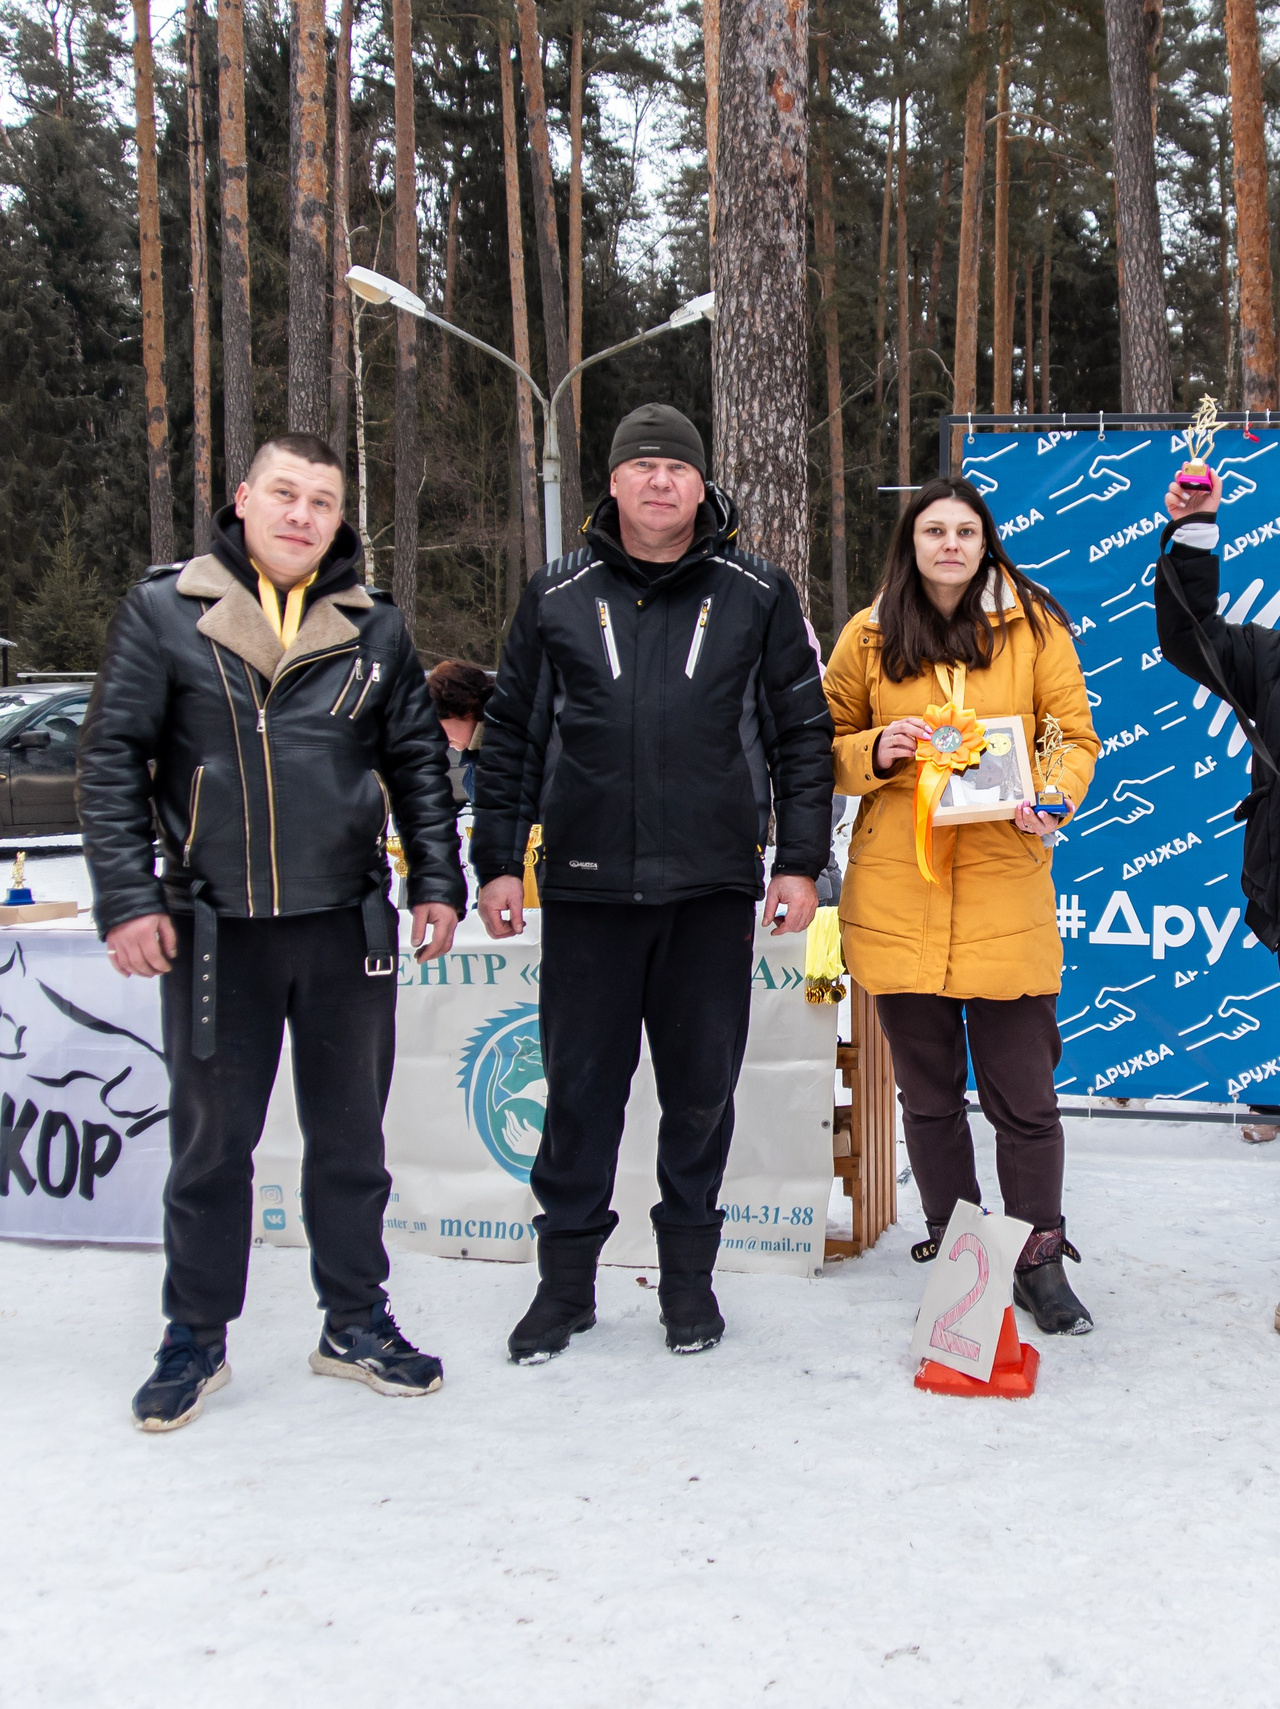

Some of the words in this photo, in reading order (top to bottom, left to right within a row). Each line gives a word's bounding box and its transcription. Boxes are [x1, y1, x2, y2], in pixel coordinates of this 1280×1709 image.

[1089, 511, 1169, 562] ДРУЖБА
[1122, 832, 1202, 881] ДРУЖБА
[397, 953, 507, 985] ЕНТР
[1095, 1043, 1174, 1091] ДРУЖБА
[0, 1091, 122, 1201] КОР
[440, 1218, 538, 1241] mcnnov
[719, 1236, 812, 1253] rnn@mail.ru
[915, 1244, 937, 1259] L&C
[929, 1233, 989, 1362] 2
